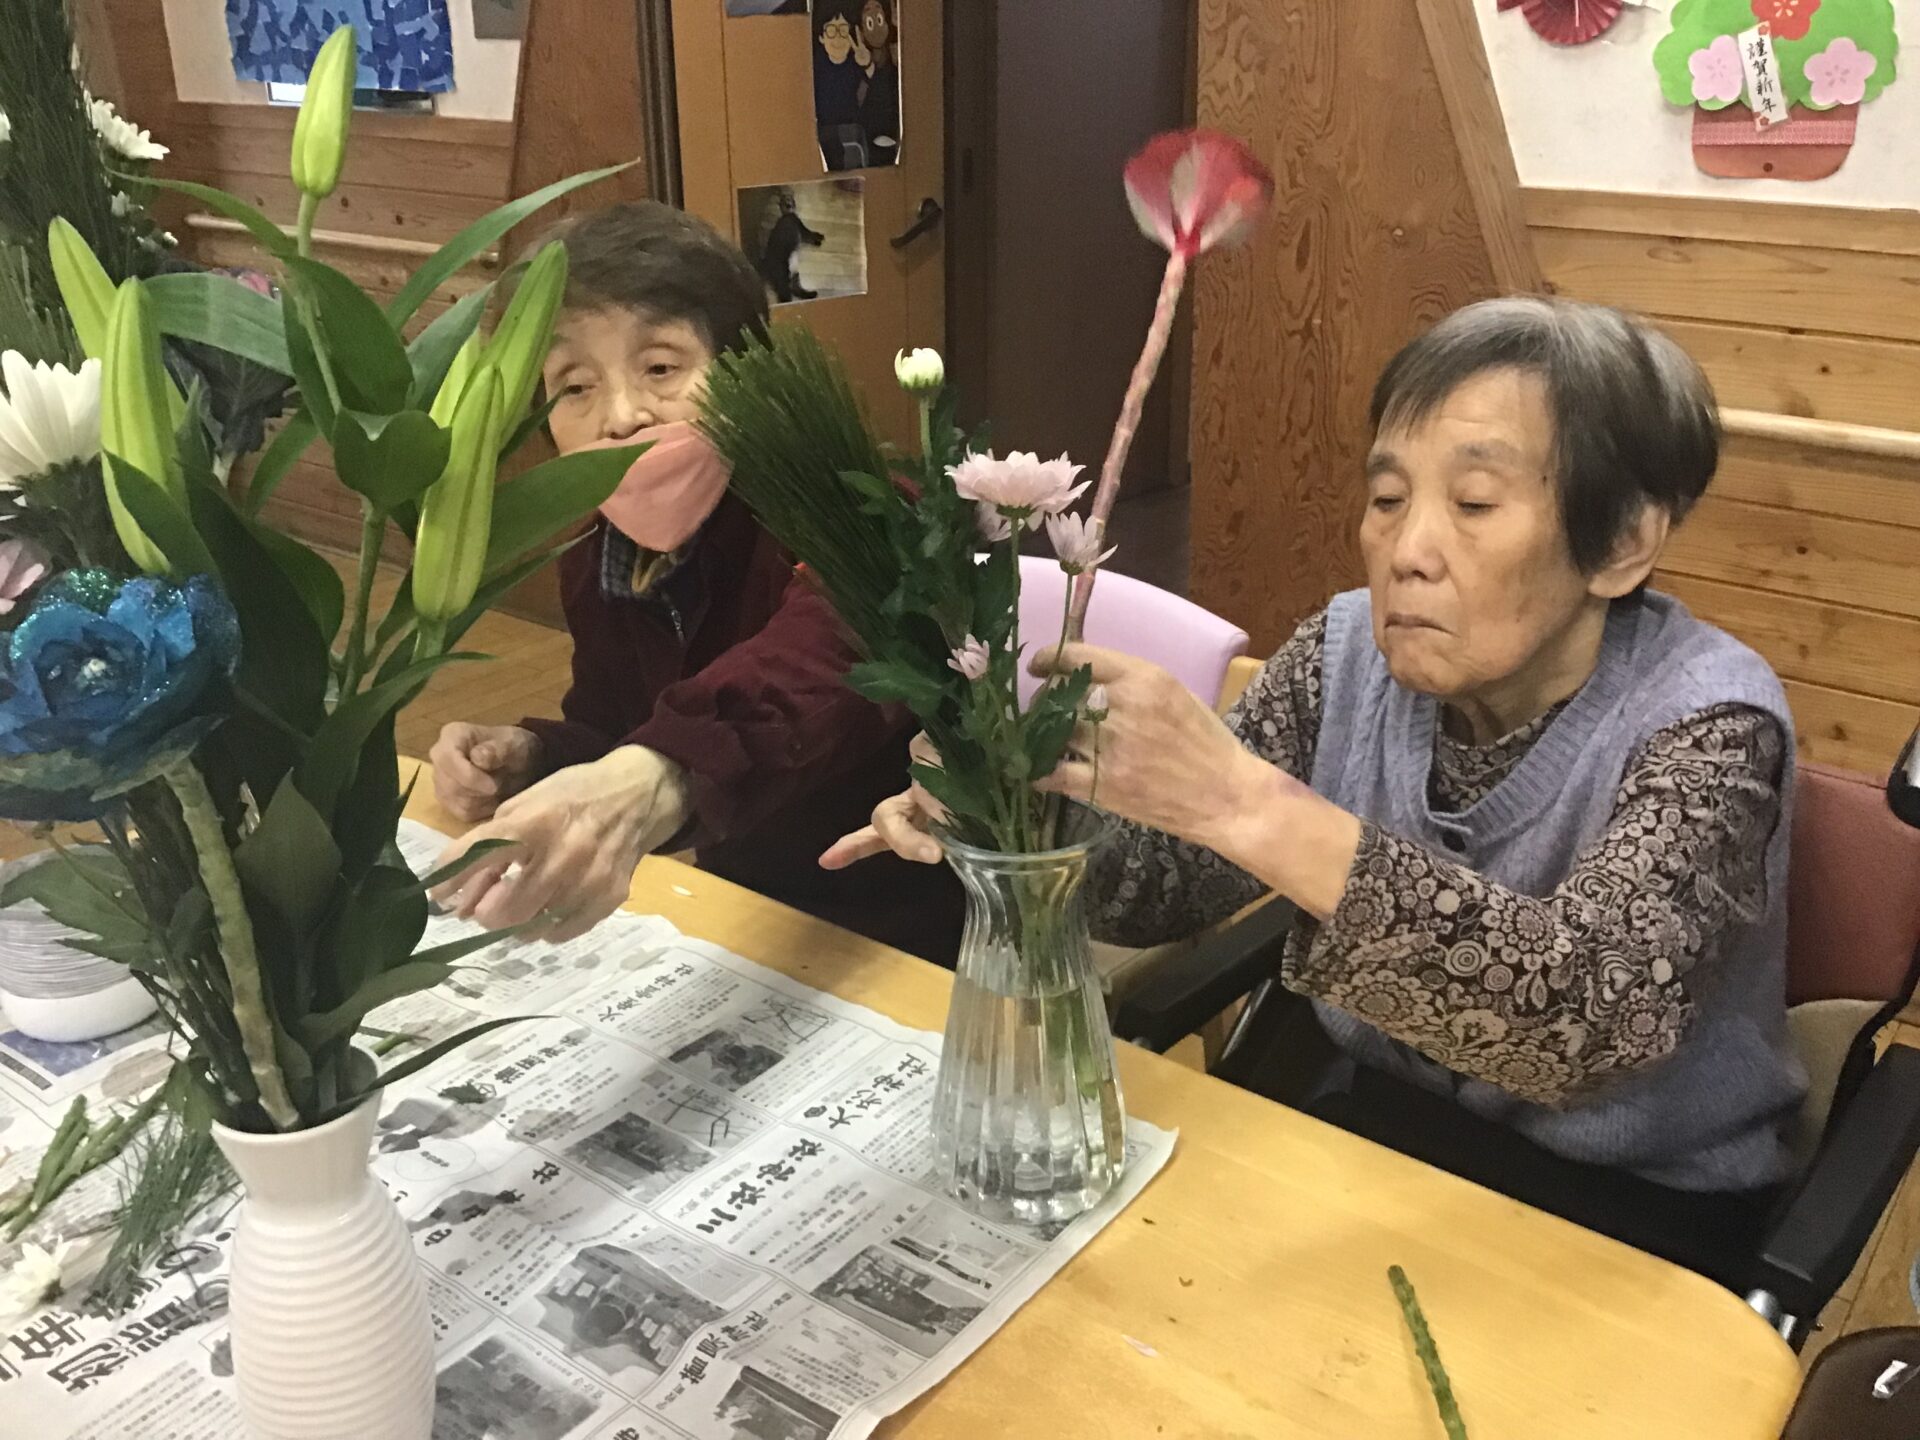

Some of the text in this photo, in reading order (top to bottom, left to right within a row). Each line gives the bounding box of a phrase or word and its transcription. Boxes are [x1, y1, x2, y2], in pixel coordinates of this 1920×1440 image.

[1747, 37, 1777, 113] 謹賀新年
[828, 1053, 930, 1129] 大形神社
[696, 1139, 824, 1234] 三社神社
[679, 1310, 769, 1385] 菅原神社
